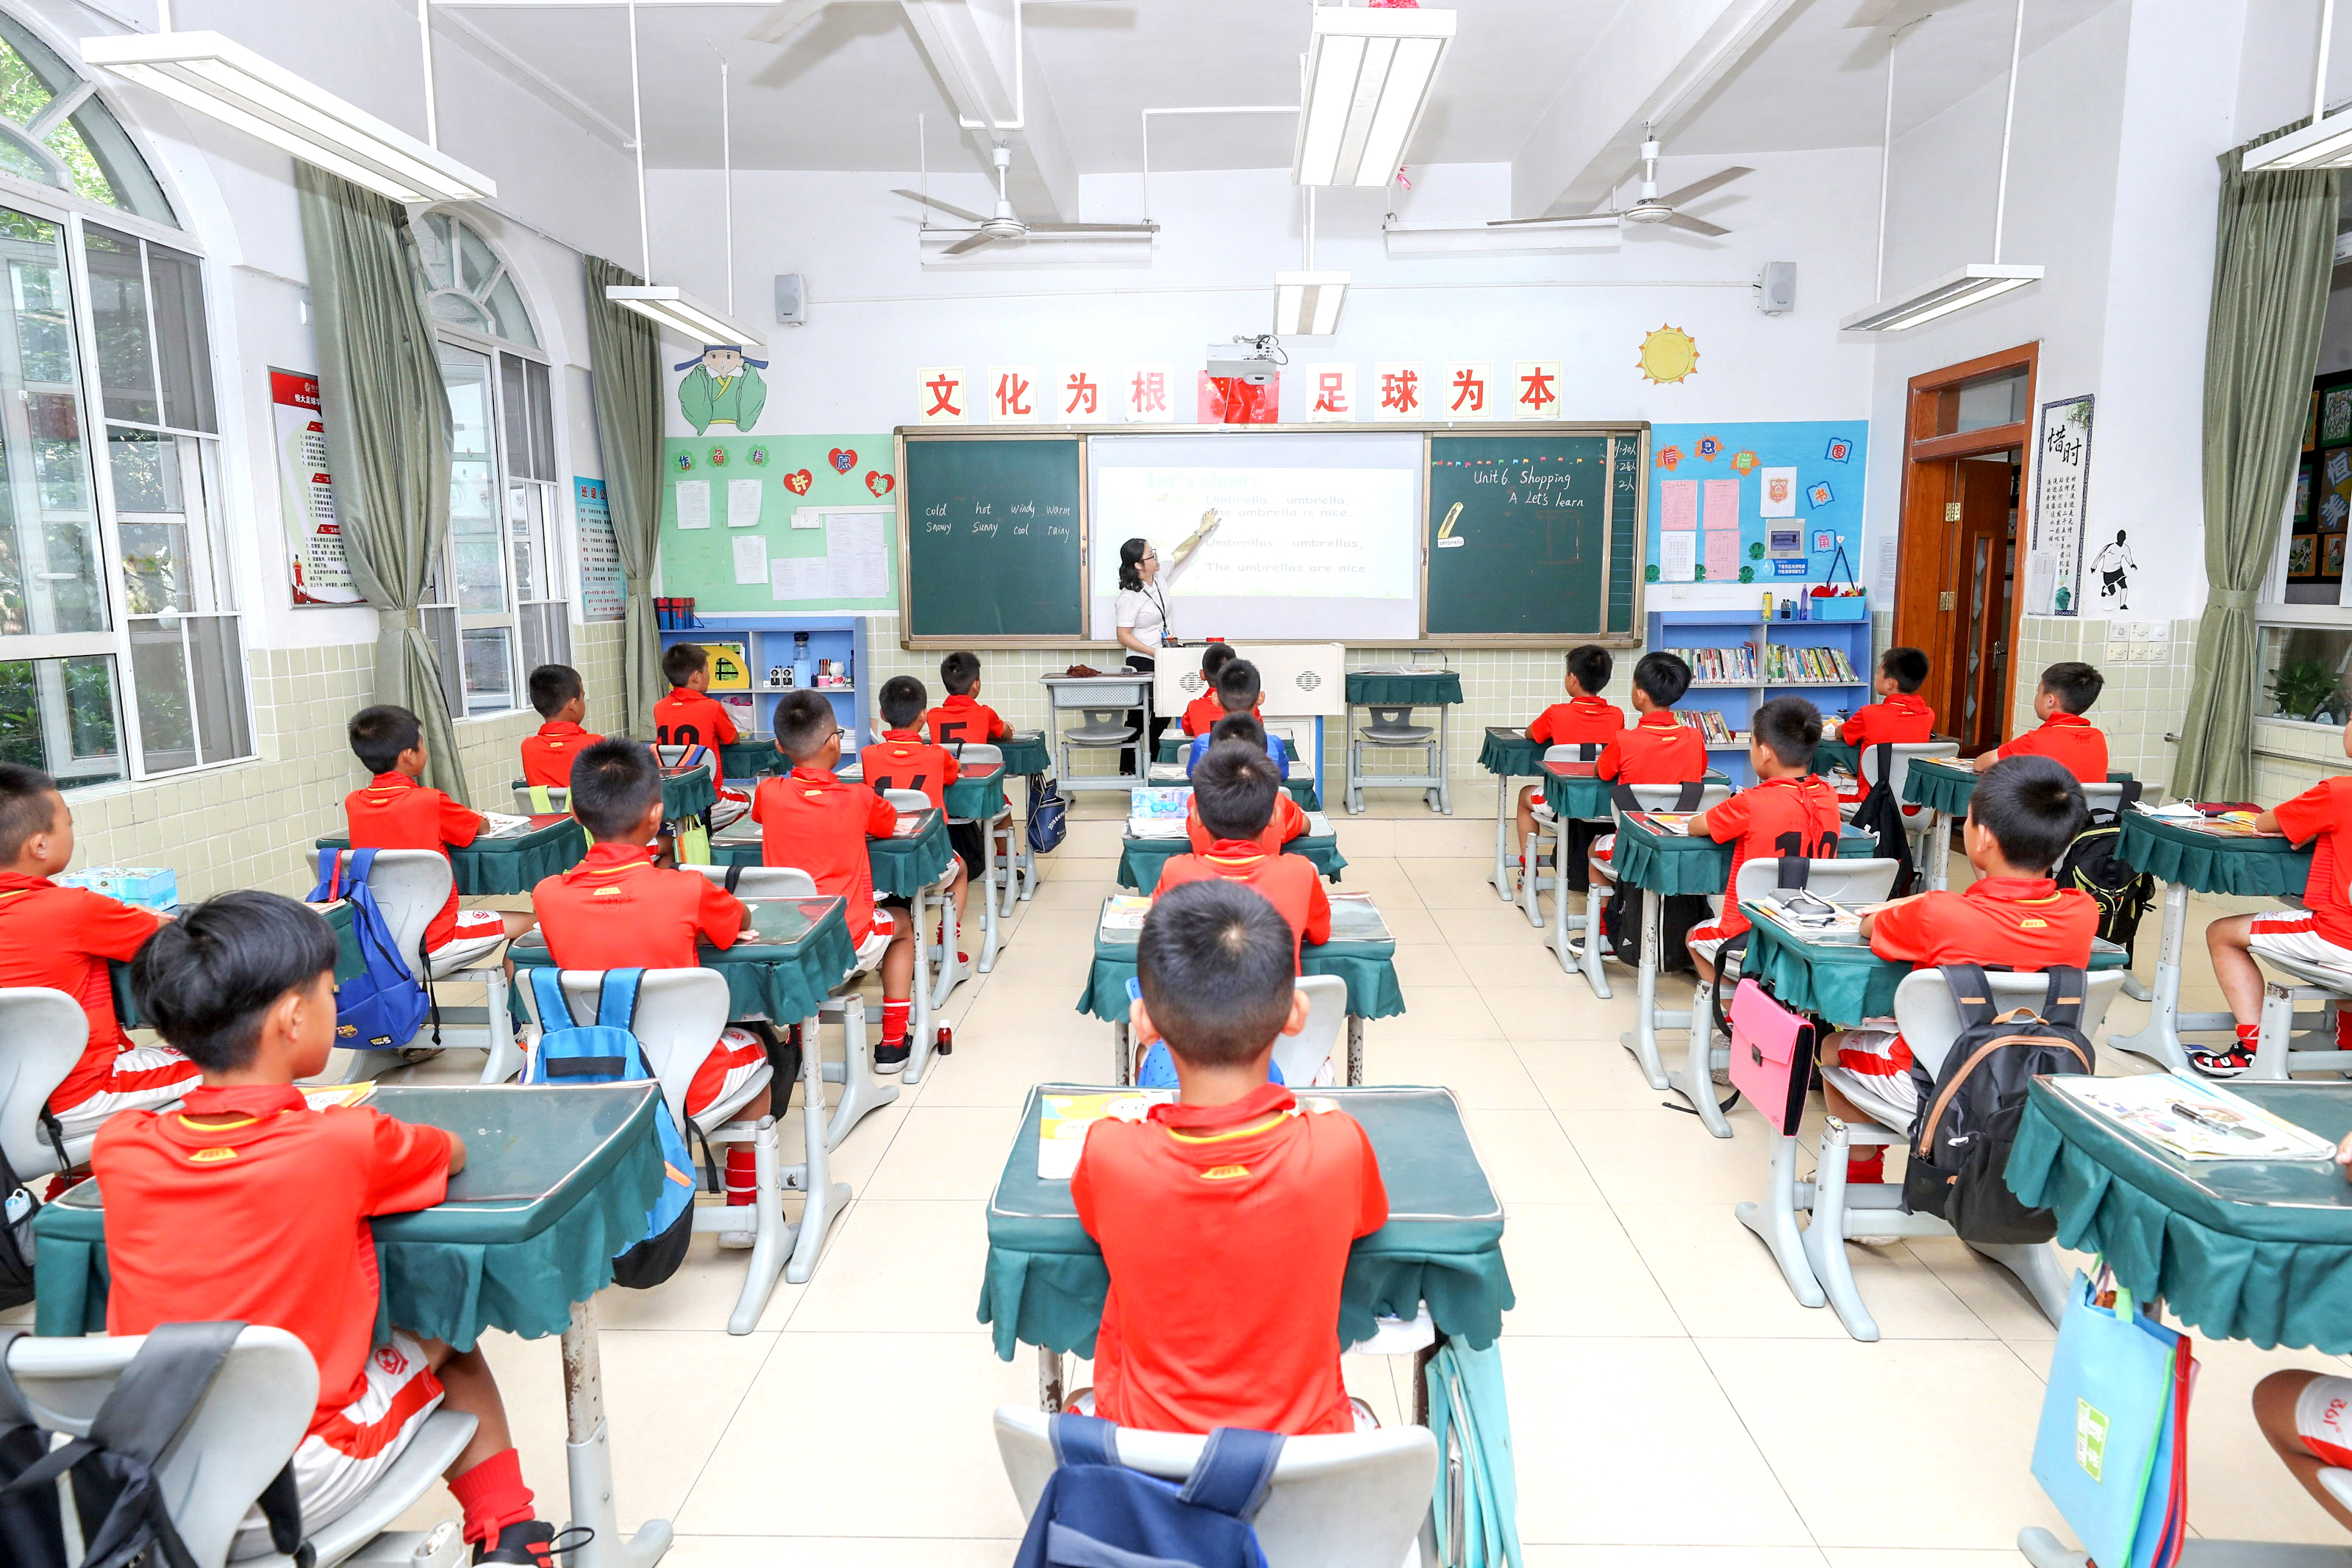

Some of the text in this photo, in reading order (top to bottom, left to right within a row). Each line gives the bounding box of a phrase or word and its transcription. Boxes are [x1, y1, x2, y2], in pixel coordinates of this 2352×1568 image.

[926, 371, 1168, 418] 文化为根
[1313, 366, 1556, 414] 足球为本
[2048, 425, 2082, 467] 惜时
[1473, 468, 1498, 484] Unit
[1520, 465, 1571, 490] Shopping
[926, 504, 947, 516] cold
[976, 501, 992, 515] hot
[1508, 491, 1584, 507] A Let's learn
[1238, 508, 1296, 517] umbrella
[1304, 509, 1314, 517] is
[1013, 523, 1029, 535] cool
[1048, 526, 1070, 544] rainy
[1206, 563, 1231, 572] The
[1237, 563, 1303, 572] umbrellas
